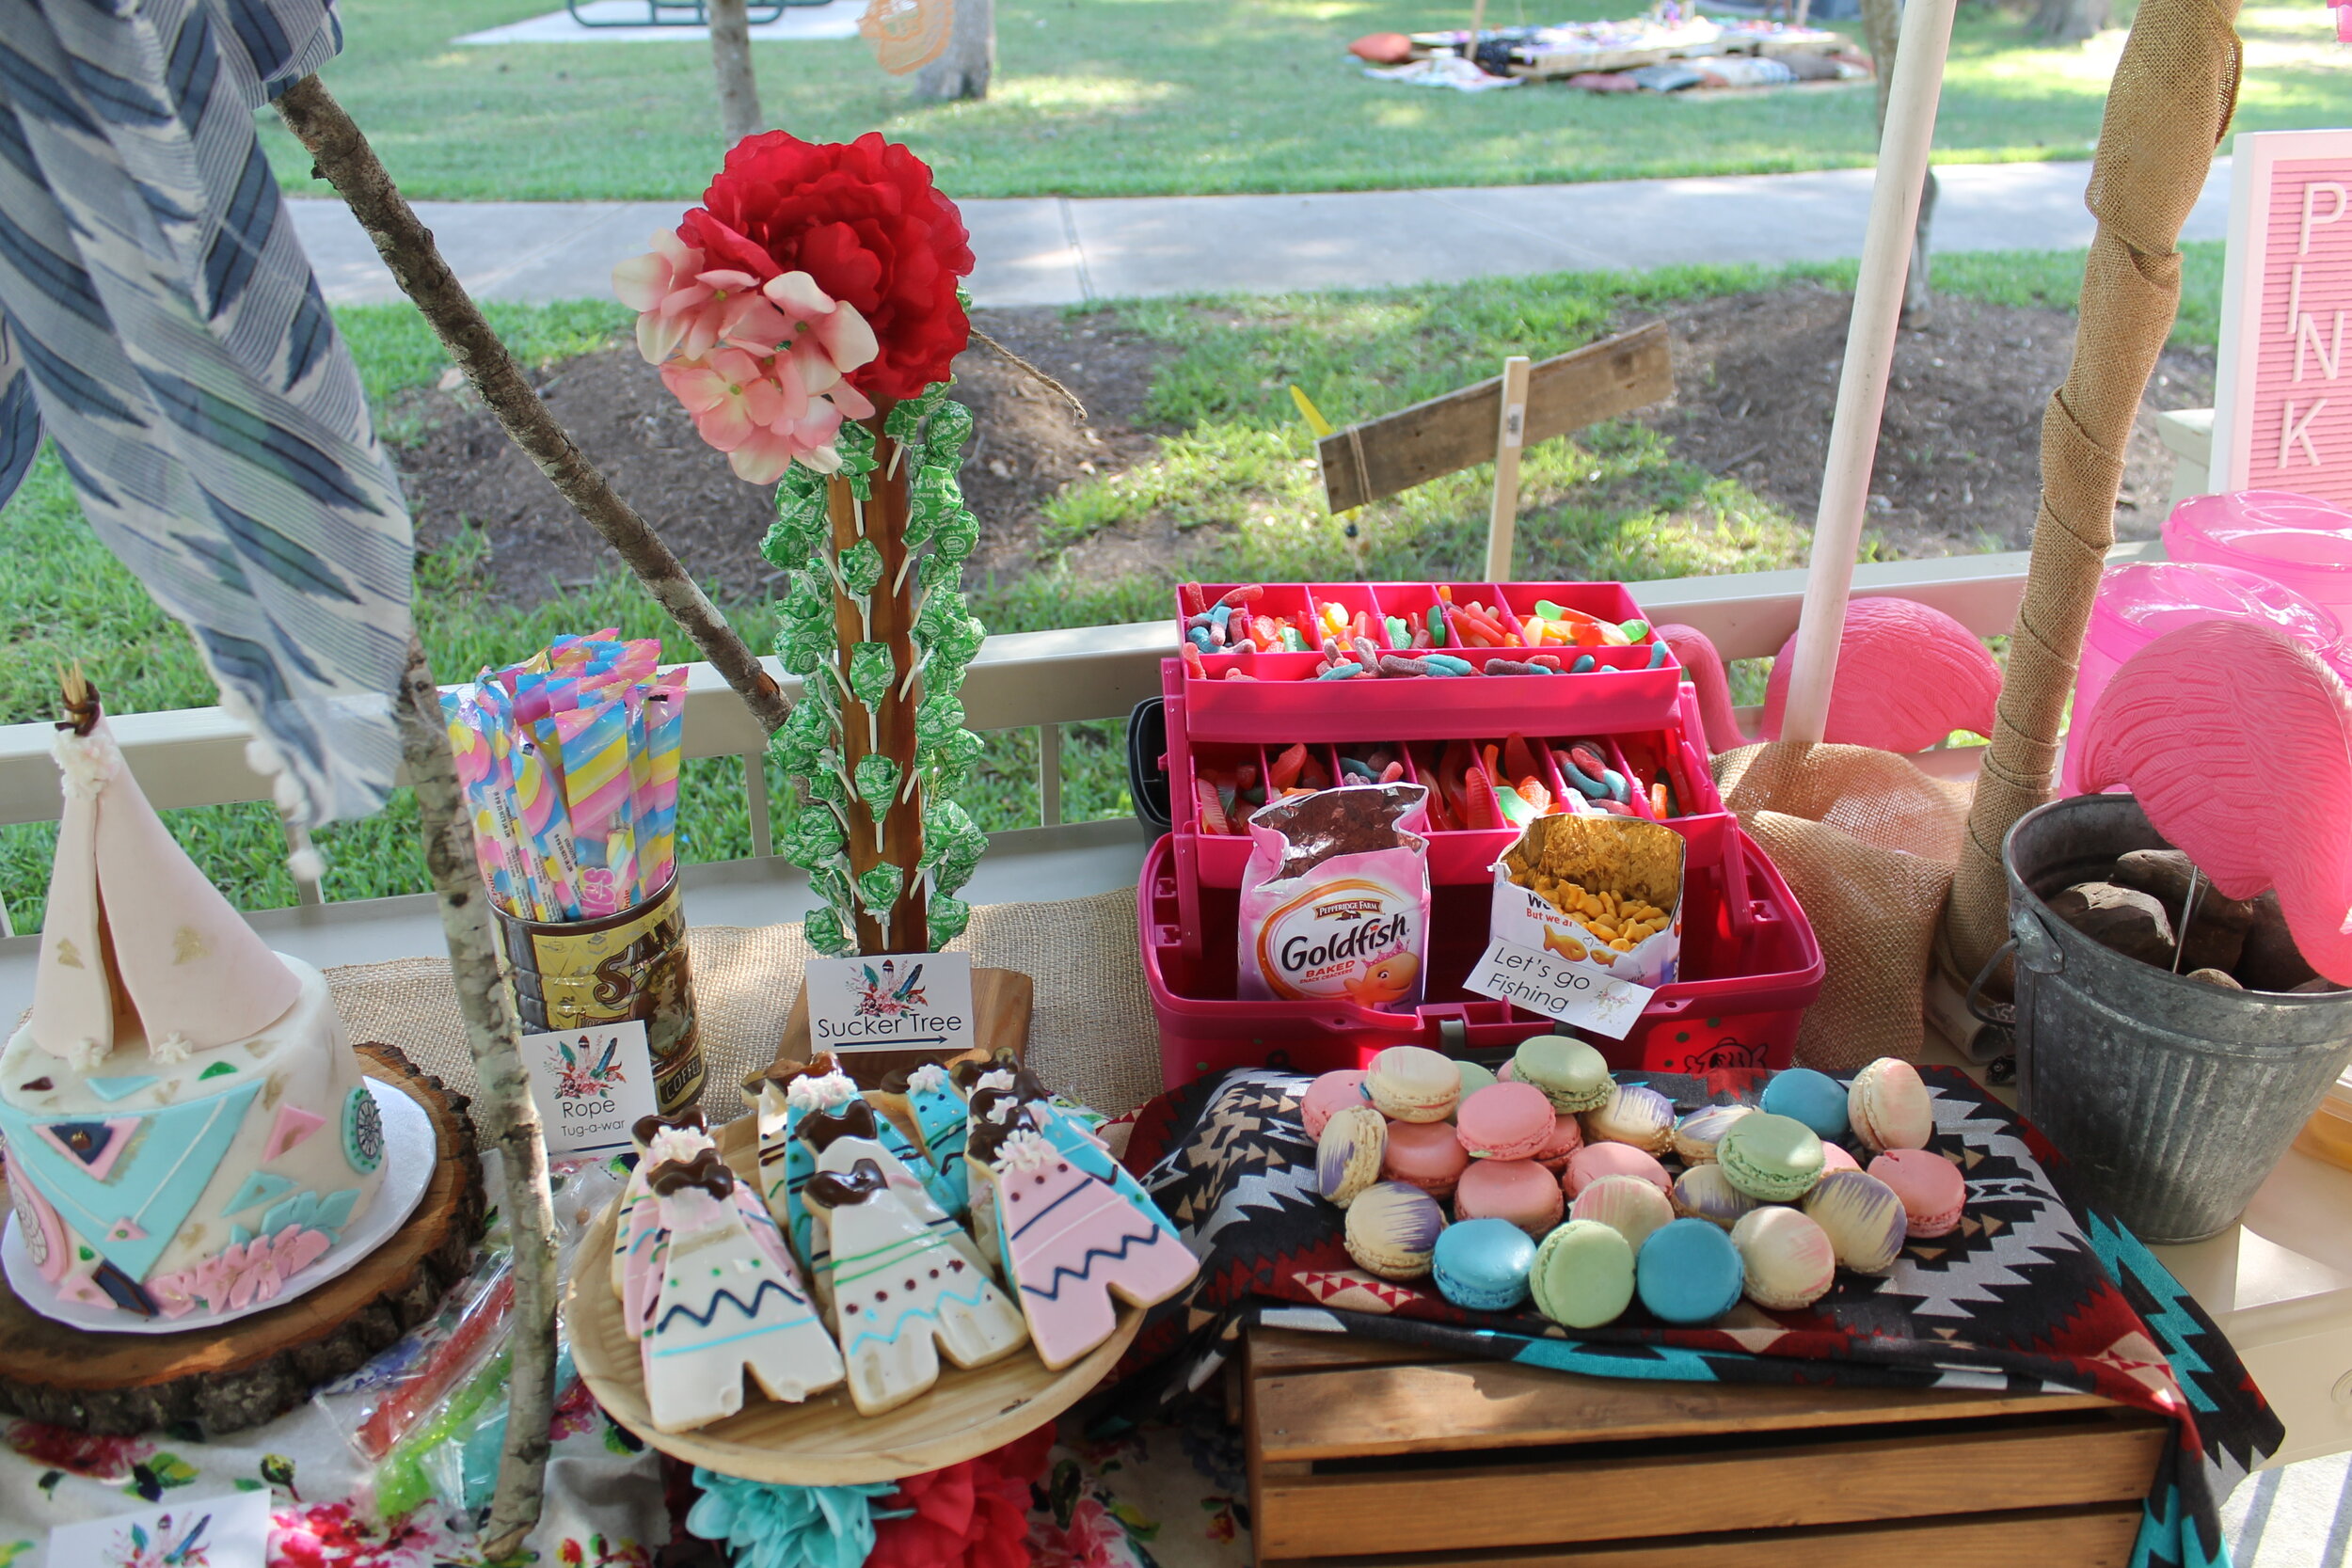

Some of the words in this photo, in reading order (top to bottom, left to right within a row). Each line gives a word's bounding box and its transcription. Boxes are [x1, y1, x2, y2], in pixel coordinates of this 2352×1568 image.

[1319, 902, 1359, 916] PEPPERIDGE
[1359, 900, 1378, 911] FARM
[1526, 908, 1543, 920] But
[1546, 914, 1560, 924] we
[1281, 913, 1406, 972] Goldfish
[1305, 959, 1355, 977] BAKED
[1494, 946, 1550, 978] Let's
[1553, 971, 1590, 990] go
[1486, 973, 1569, 1014] Fishing
[818, 1016, 902, 1038] Sucker
[909, 1013, 961, 1032] Tree
[563, 1099, 615, 1119] Rope
[561, 1119, 625, 1138] Tug-a-war
